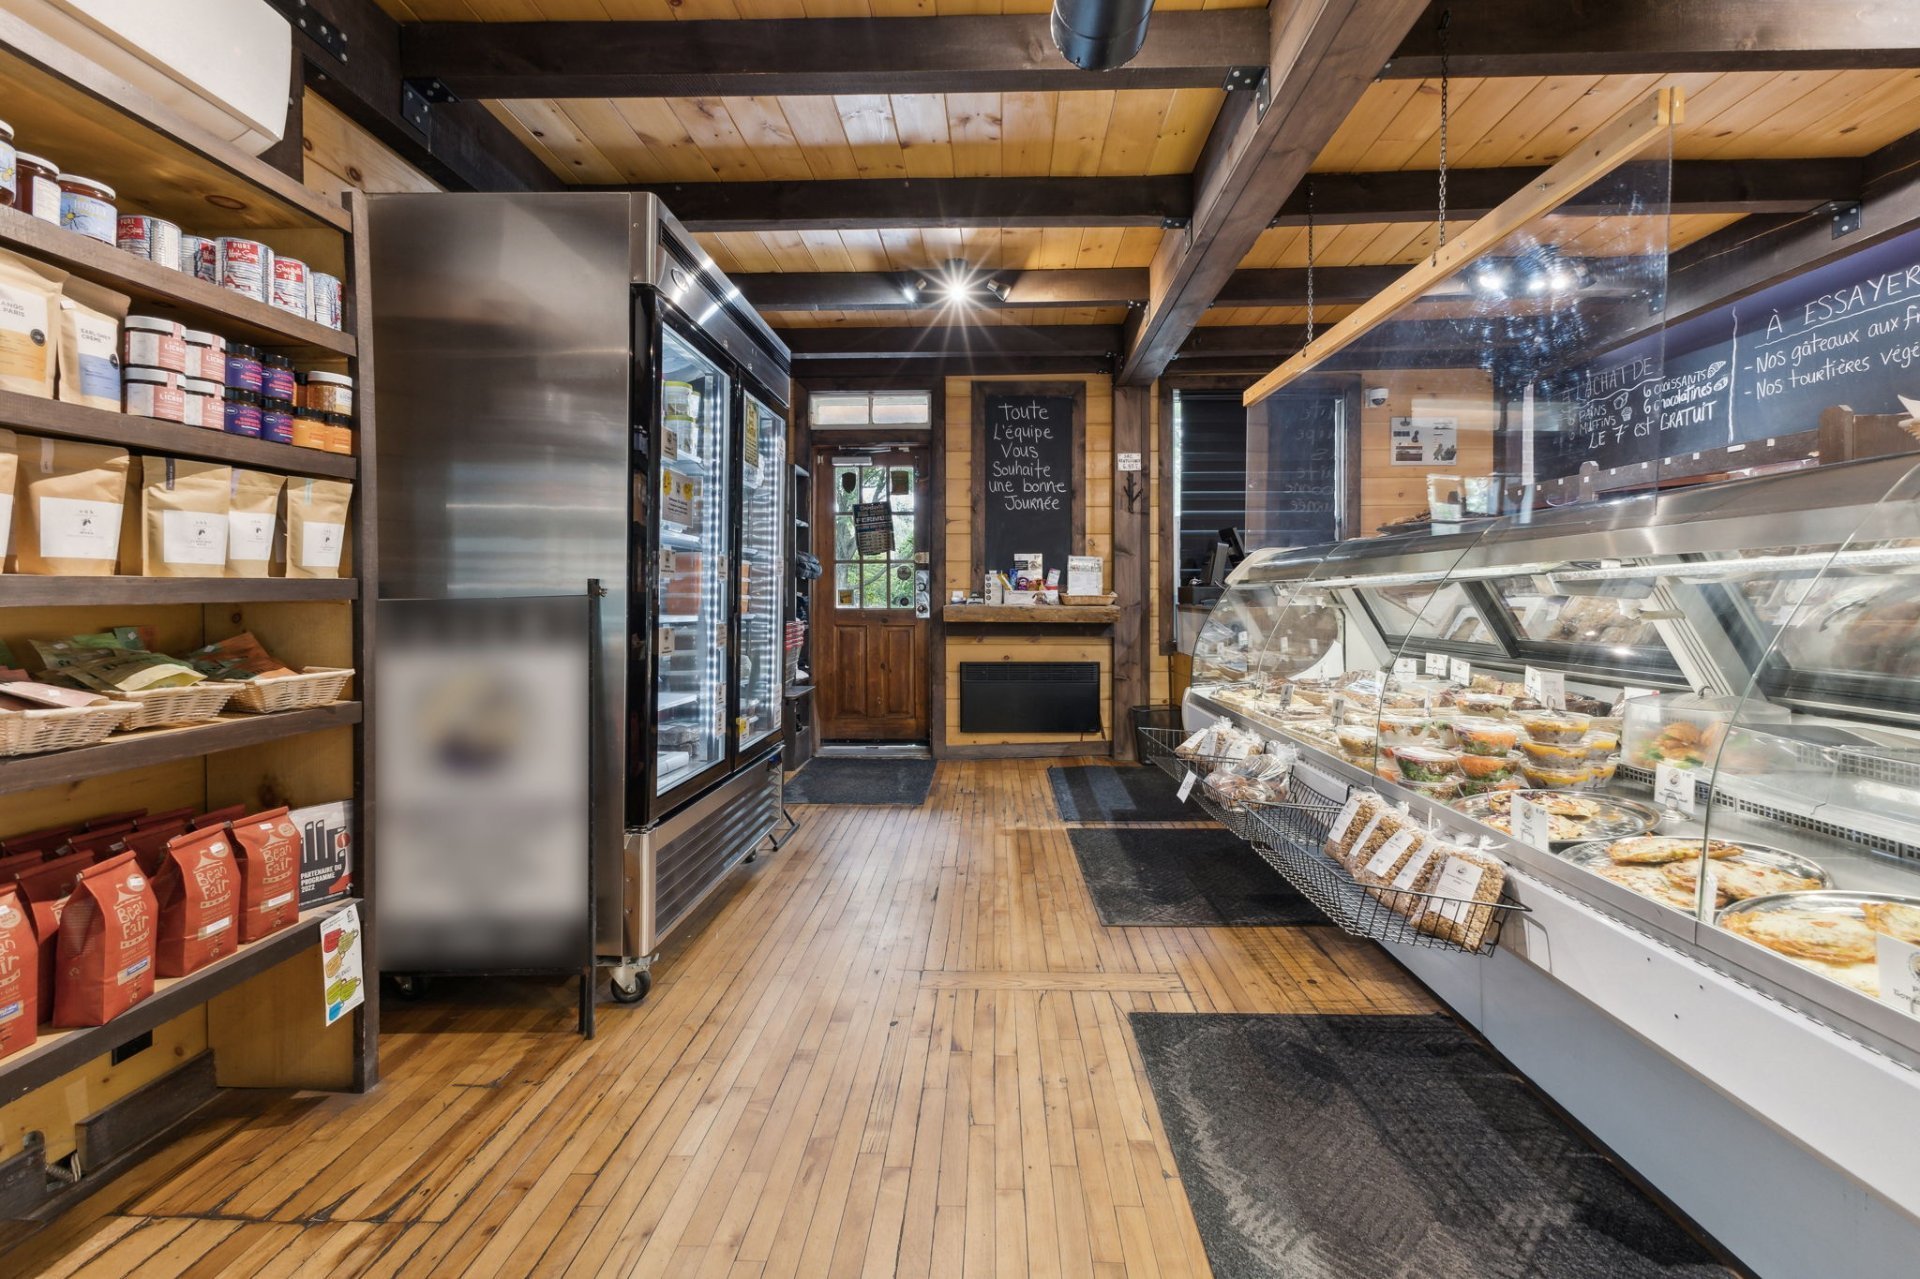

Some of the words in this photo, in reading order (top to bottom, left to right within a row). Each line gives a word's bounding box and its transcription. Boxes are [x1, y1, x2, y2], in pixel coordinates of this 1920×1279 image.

[1766, 308, 1783, 340] À
[1803, 265, 1920, 325] ESSAYER
[1791, 329, 1860, 367] gâteaux
[1868, 317, 1899, 338] aux
[1632, 357, 1655, 381] DE
[998, 400, 1049, 421] Toute
[1644, 398, 1652, 414] 6
[993, 423, 1054, 444] L'équipe
[1588, 430, 1606, 449] LE
[1634, 416, 1655, 438] est
[1001, 442, 1039, 459] Vous
[992, 458, 1051, 479] Souhaite
[989, 480, 1015, 493] une
[1023, 478, 1067, 494] bonne
[1004, 495, 1061, 511] Journée
[262, 845, 292, 864] Bean
[195, 866, 227, 888] Bean
[266, 857, 293, 877] Fair
[202, 880, 230, 900] Fair
[117, 900, 148, 924] Bean
[122, 915, 149, 940] Fair
